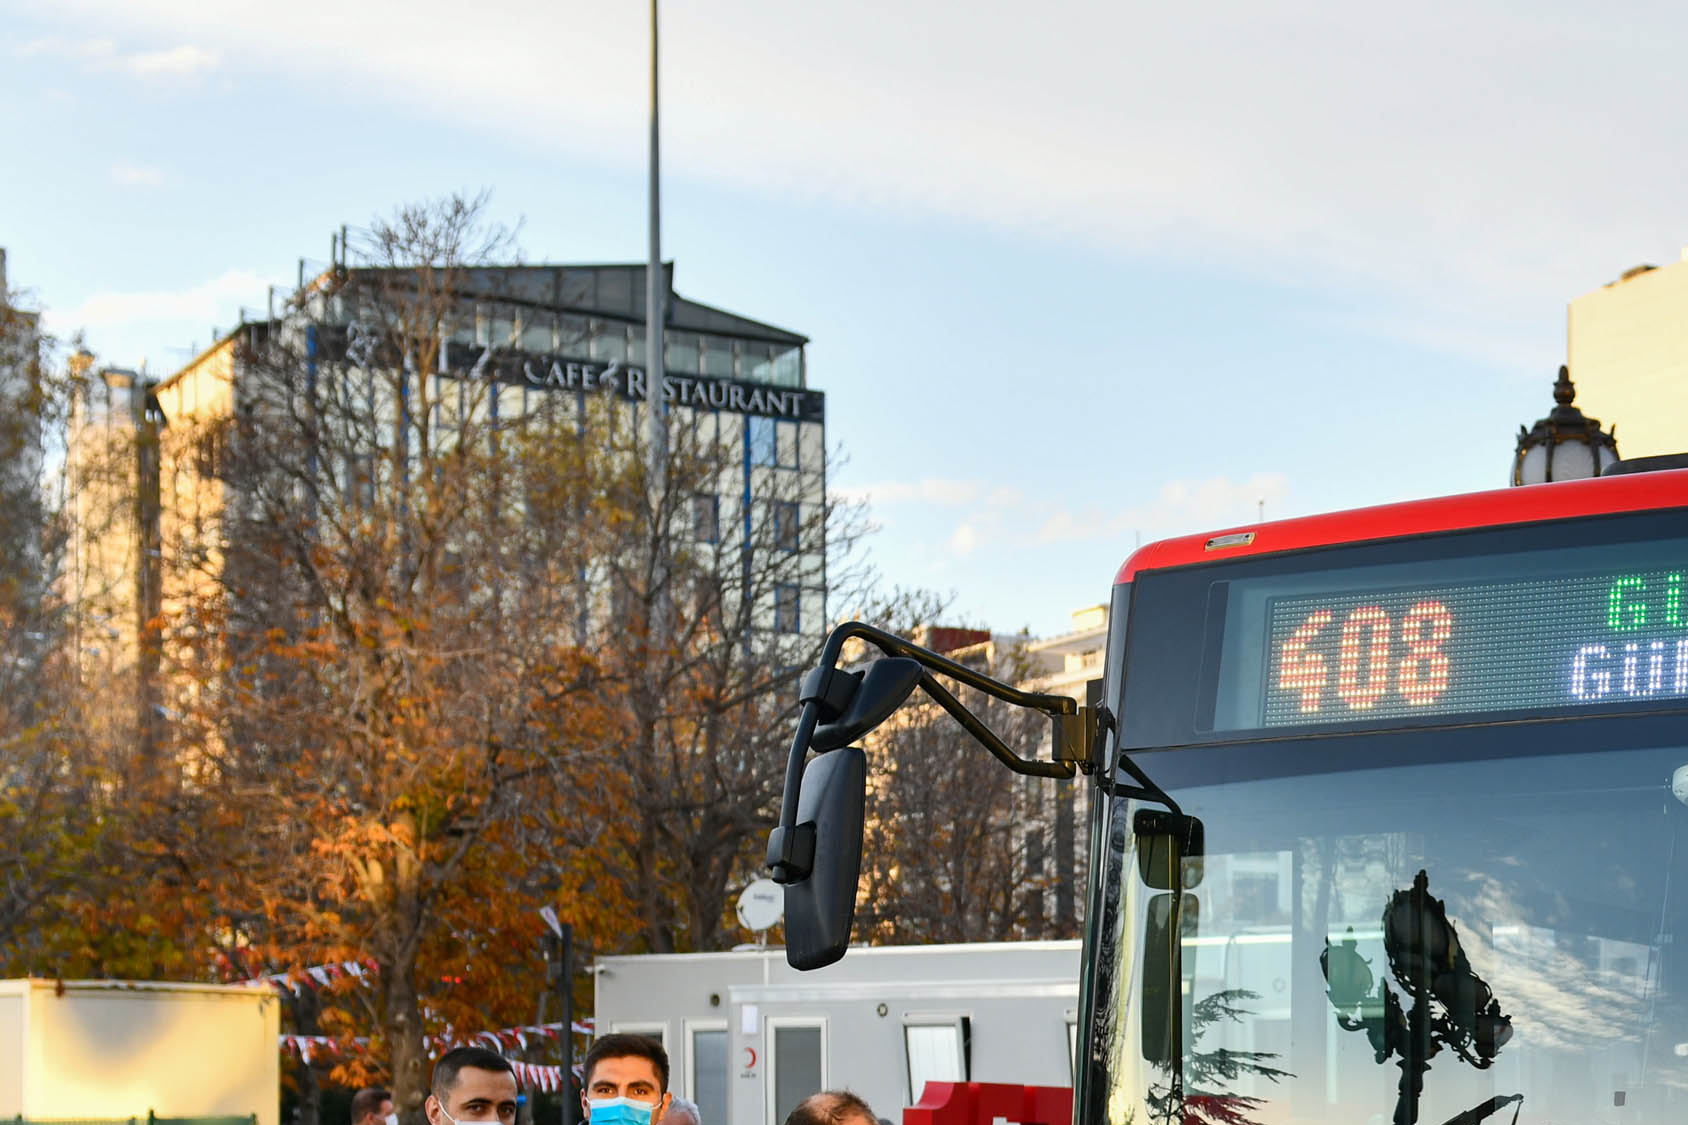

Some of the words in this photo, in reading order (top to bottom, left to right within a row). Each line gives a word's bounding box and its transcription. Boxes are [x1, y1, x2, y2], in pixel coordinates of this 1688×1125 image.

[524, 357, 595, 389] CAFE
[628, 367, 805, 417] RSTAURANT
[1279, 600, 1452, 713] 408
